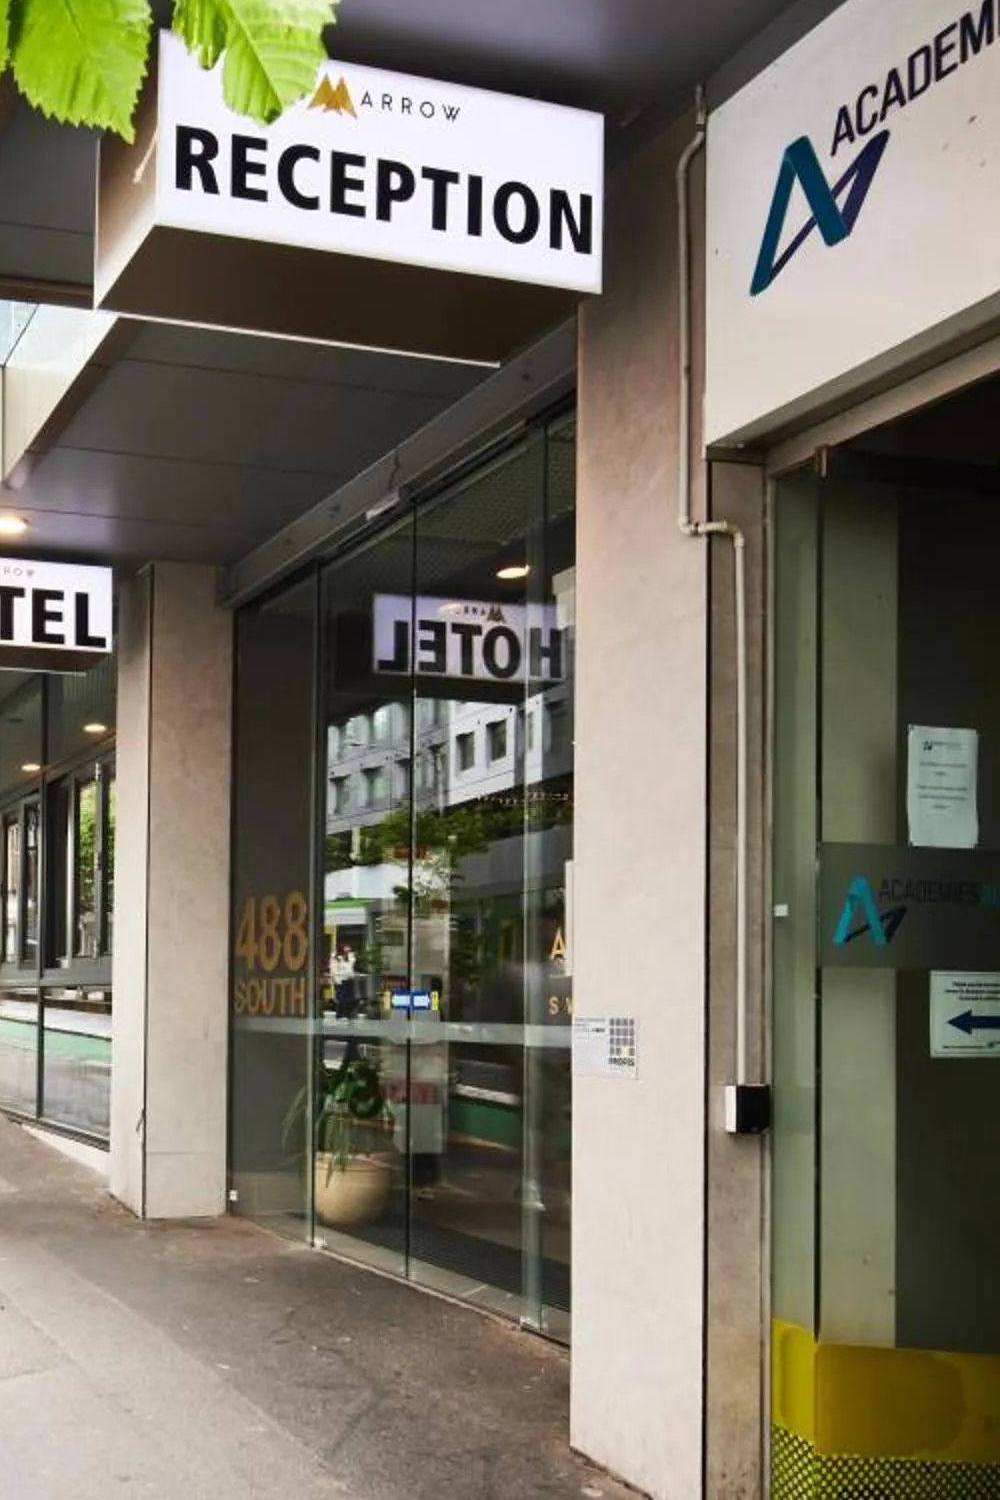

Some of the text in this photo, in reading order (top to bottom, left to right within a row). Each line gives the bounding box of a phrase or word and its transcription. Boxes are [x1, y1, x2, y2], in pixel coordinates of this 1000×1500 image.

[360, 90, 462, 123] ARROW
[175, 124, 593, 255] RECEPTION
[234, 890, 309, 972] 488
[234, 977, 306, 1016] SOUTH
